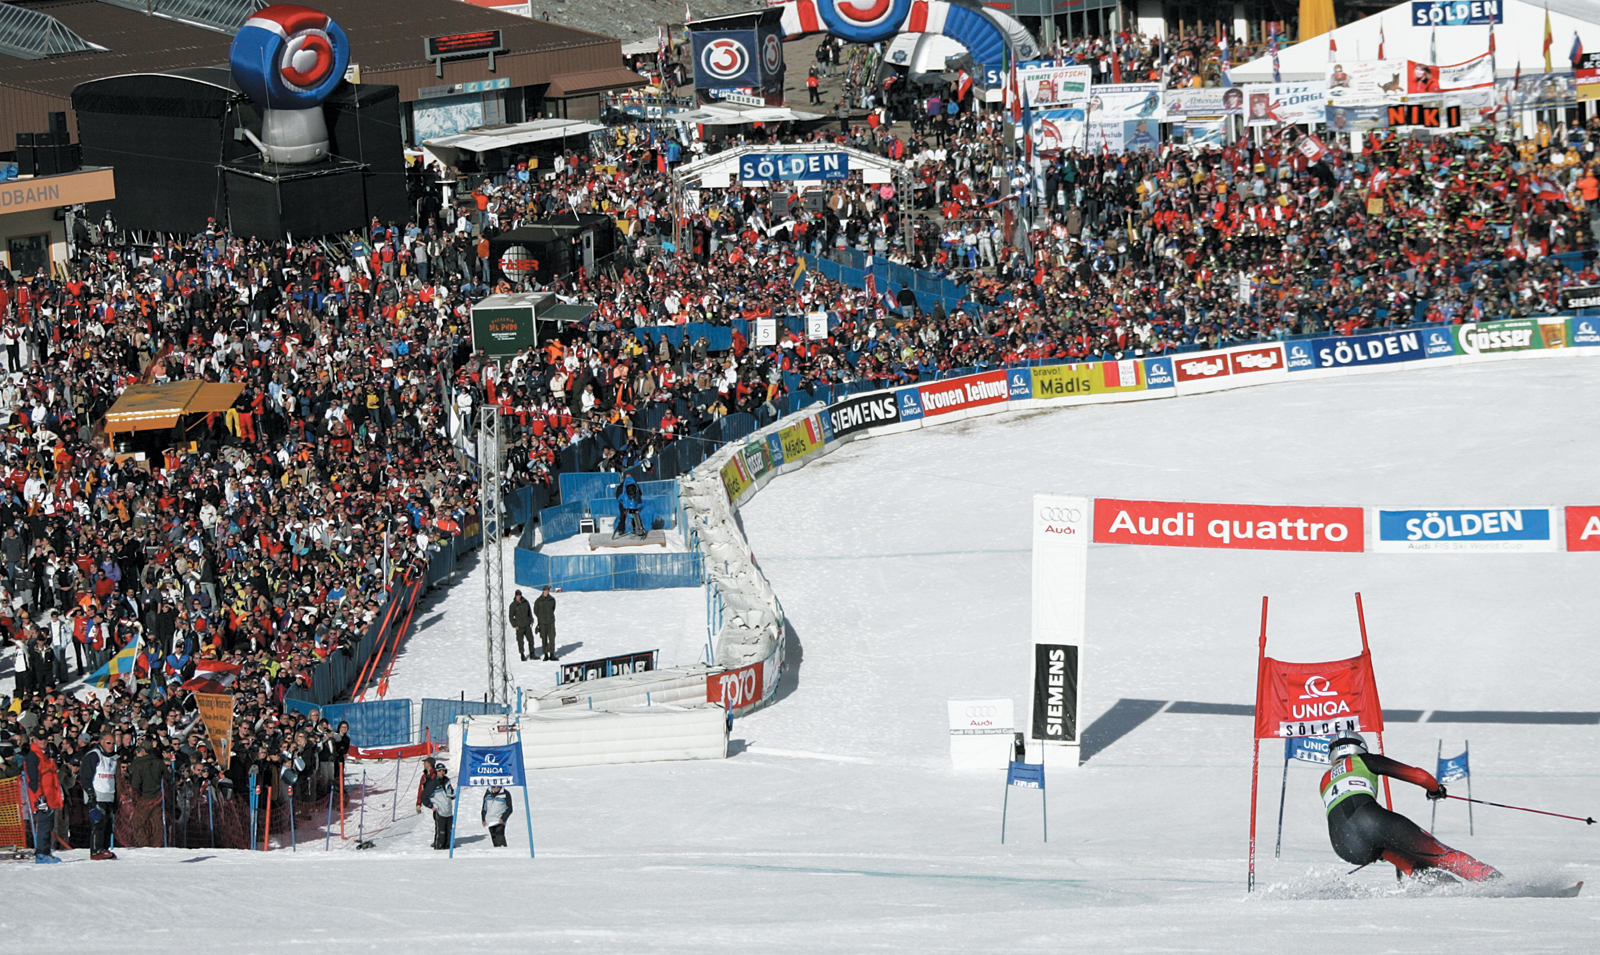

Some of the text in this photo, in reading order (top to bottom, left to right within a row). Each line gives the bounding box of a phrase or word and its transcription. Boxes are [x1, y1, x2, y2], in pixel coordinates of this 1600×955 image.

[1416, 1, 1498, 24] SÖLDEN
[1388, 105, 1457, 127] NIKI
[743, 154, 840, 179] SÖLDEN
[0, 184, 60, 206] DBAHN
[498, 258, 539, 271] FABER
[762, 328, 770, 338] 5
[814, 323, 821, 333] 2
[1458, 323, 1532, 355] Gösser
[1320, 333, 1419, 367] SÖLDEN
[1427, 345, 1452, 354] UNIQA
[1181, 358, 1223, 376] Tirol
[1236, 351, 1277, 369] Tirol
[1288, 358, 1312, 367] UNIQA
[1033, 367, 1061, 376] bravo!
[1148, 375, 1173, 384] UNIQA
[921, 377, 1008, 411] Kronen Zeitung
[1009, 387, 1029, 395] UNIQA
[1040, 378, 1091, 395] Mädls
[831, 398, 897, 433] SIEMENS
[901, 407, 922, 417] UNIQA
[1045, 525, 1075, 535] Audi
[1108, 510, 1349, 544] Audi quattro
[1406, 510, 1524, 541] SÖLDEN
[1502, 542, 1523, 551] Cup
[719, 668, 756, 706] TOTO
[1047, 649, 1065, 735] SIEMENS
[1292, 700, 1350, 719] UNIQA
[1286, 720, 1355, 736] SÖLDEN
[1303, 740, 1330, 752] UNIQ
[1331, 784, 1339, 796] 4
